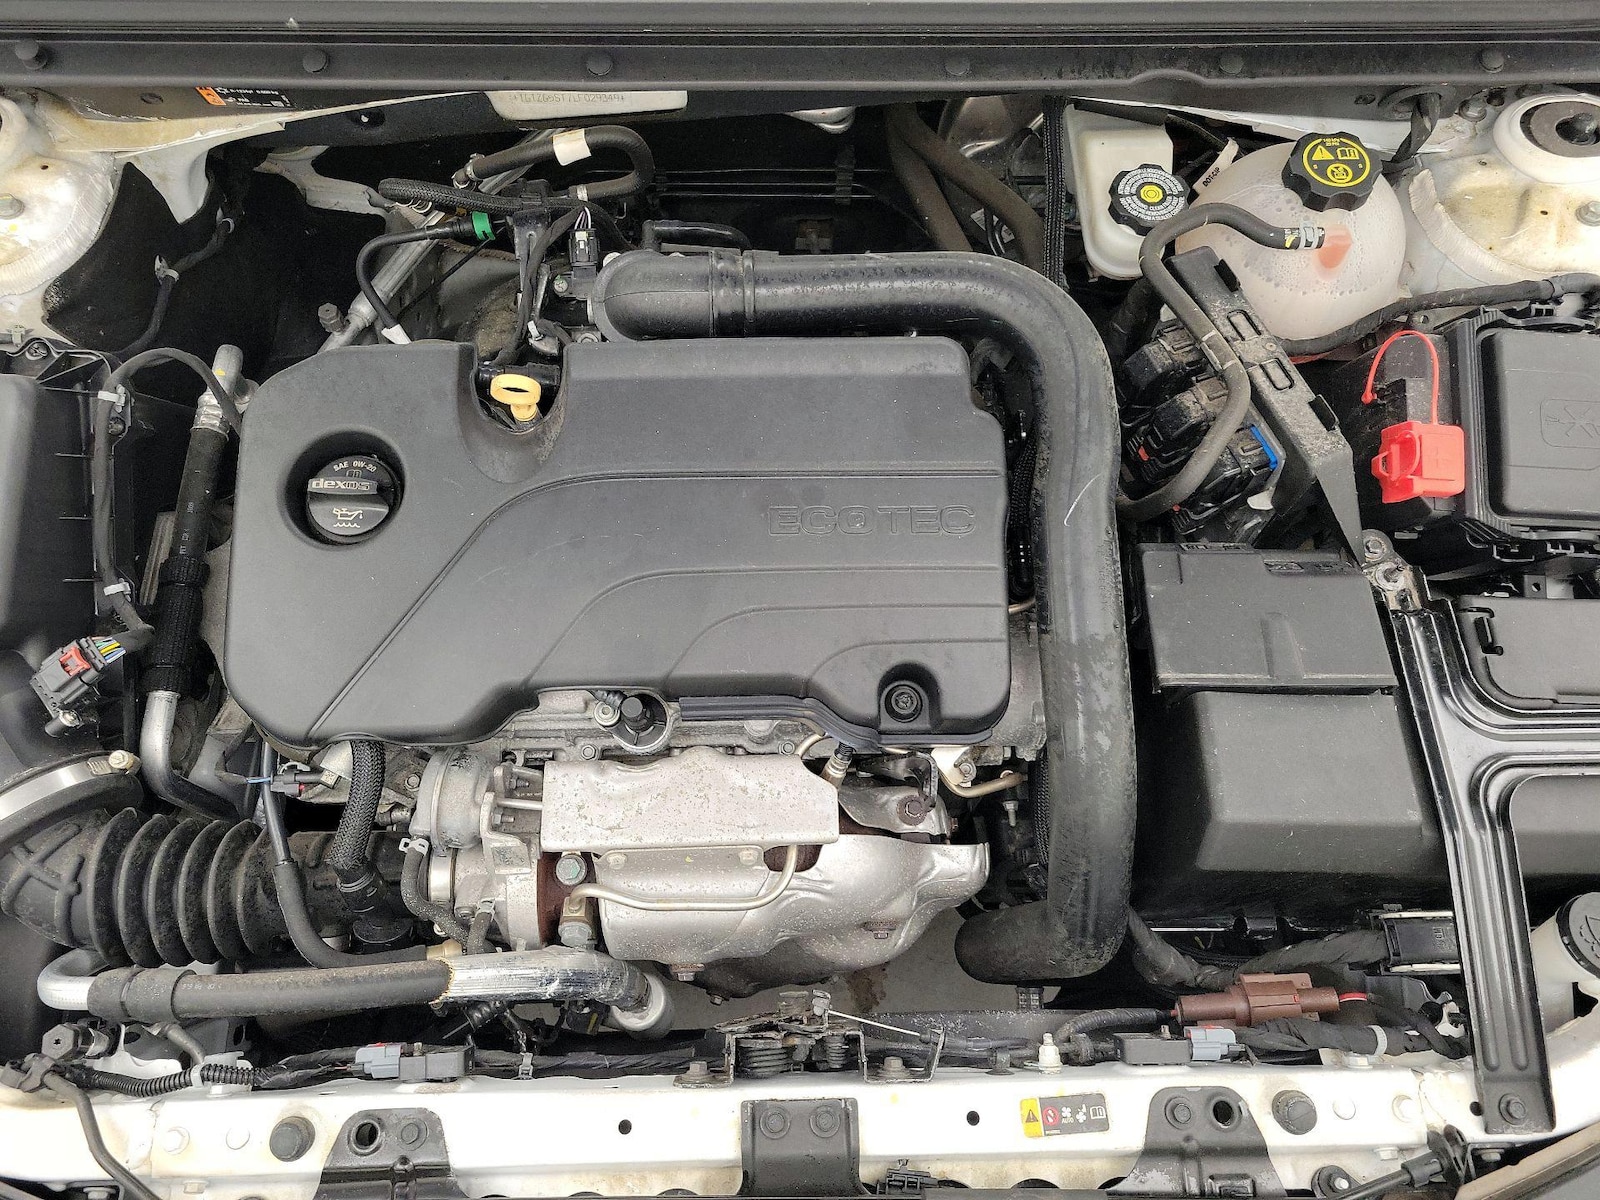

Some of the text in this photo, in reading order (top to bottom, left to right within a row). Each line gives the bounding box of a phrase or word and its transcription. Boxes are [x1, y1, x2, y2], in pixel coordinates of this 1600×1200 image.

[333, 460, 377, 473] SAE 0W-20
[311, 478, 370, 491] dexos
[767, 504, 976, 536] ECOTEC
